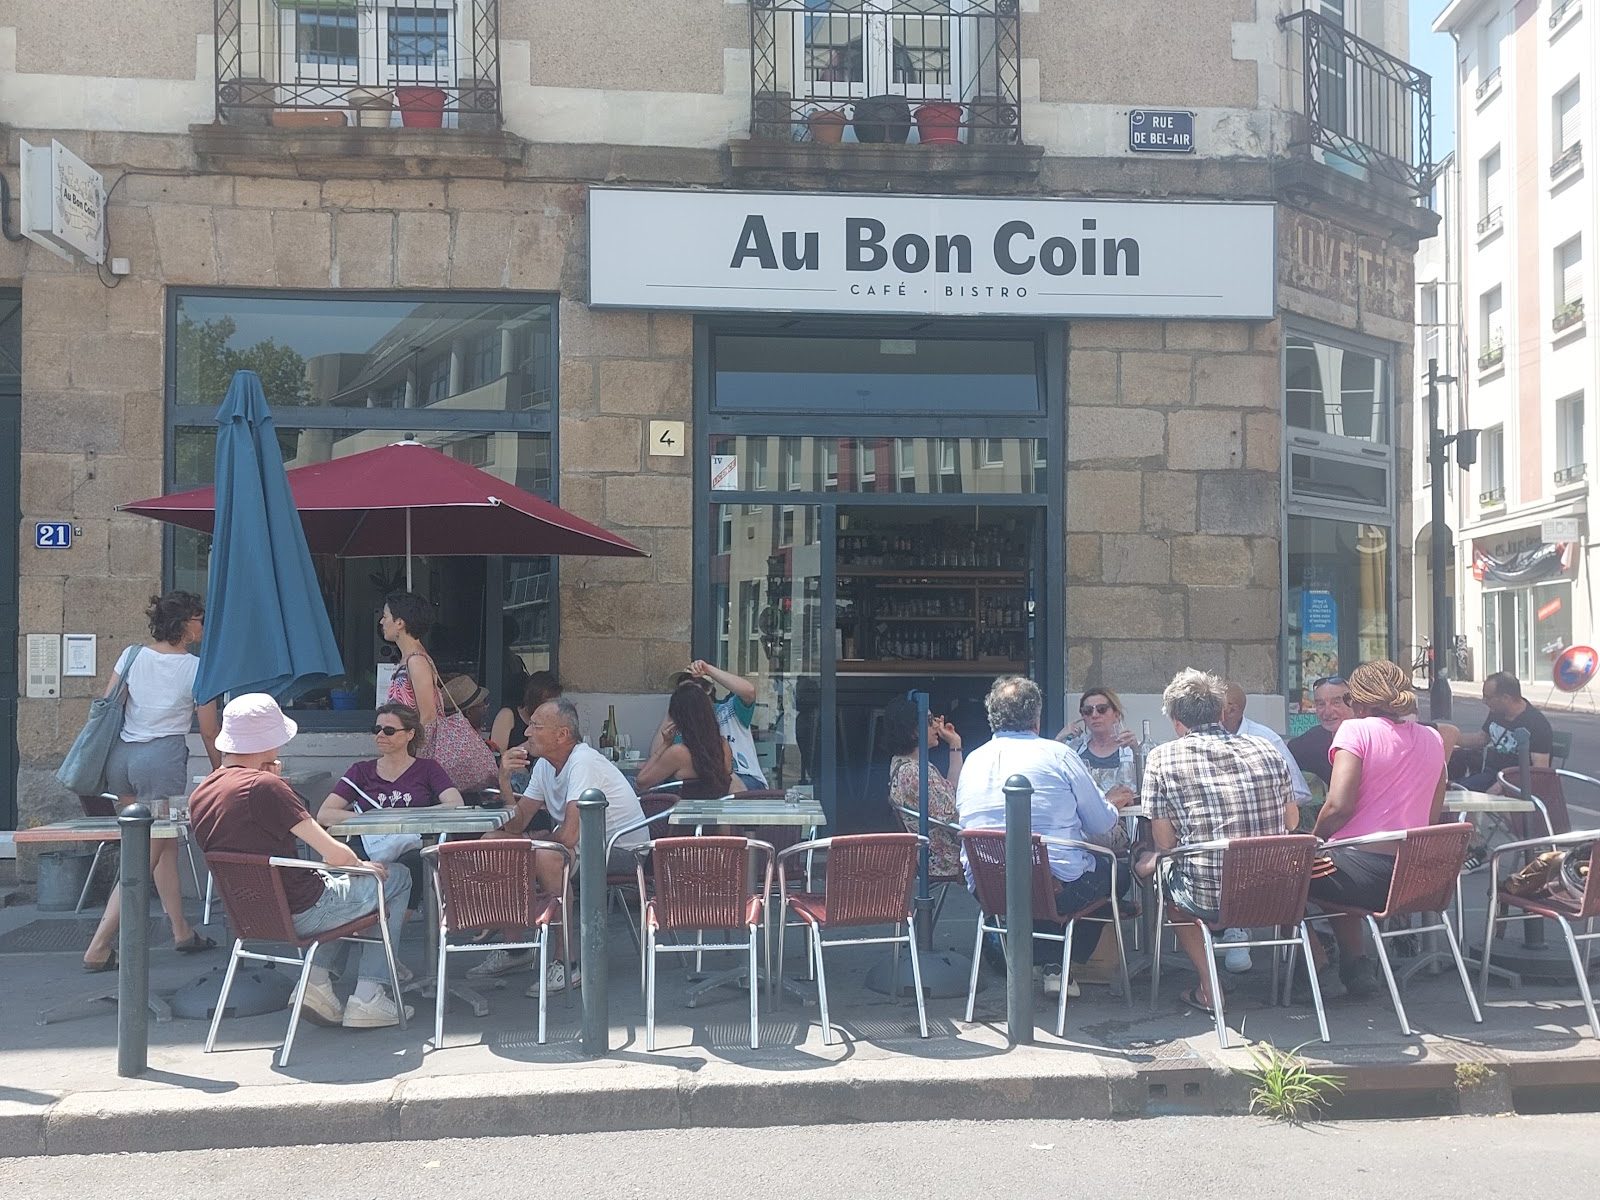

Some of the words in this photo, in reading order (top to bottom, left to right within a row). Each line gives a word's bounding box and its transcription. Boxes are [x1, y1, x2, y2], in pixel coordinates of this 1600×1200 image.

[1152, 116, 1174, 128] RUE
[1134, 132, 1147, 144] DE
[1150, 132, 1190, 145] BEL-AIR
[63, 188, 71, 201] Au
[72, 193, 84, 209] Bon
[84, 202, 96, 219] Coin
[729, 214, 819, 271] Au
[845, 217, 972, 274] Bon
[993, 218, 1140, 277] Coin
[850, 281, 906, 296] CAFÉ
[945, 285, 1027, 298] BISTRO
[660, 429, 675, 447] 4
[713, 457, 723, 465] IV
[39, 525, 67, 546] 21
